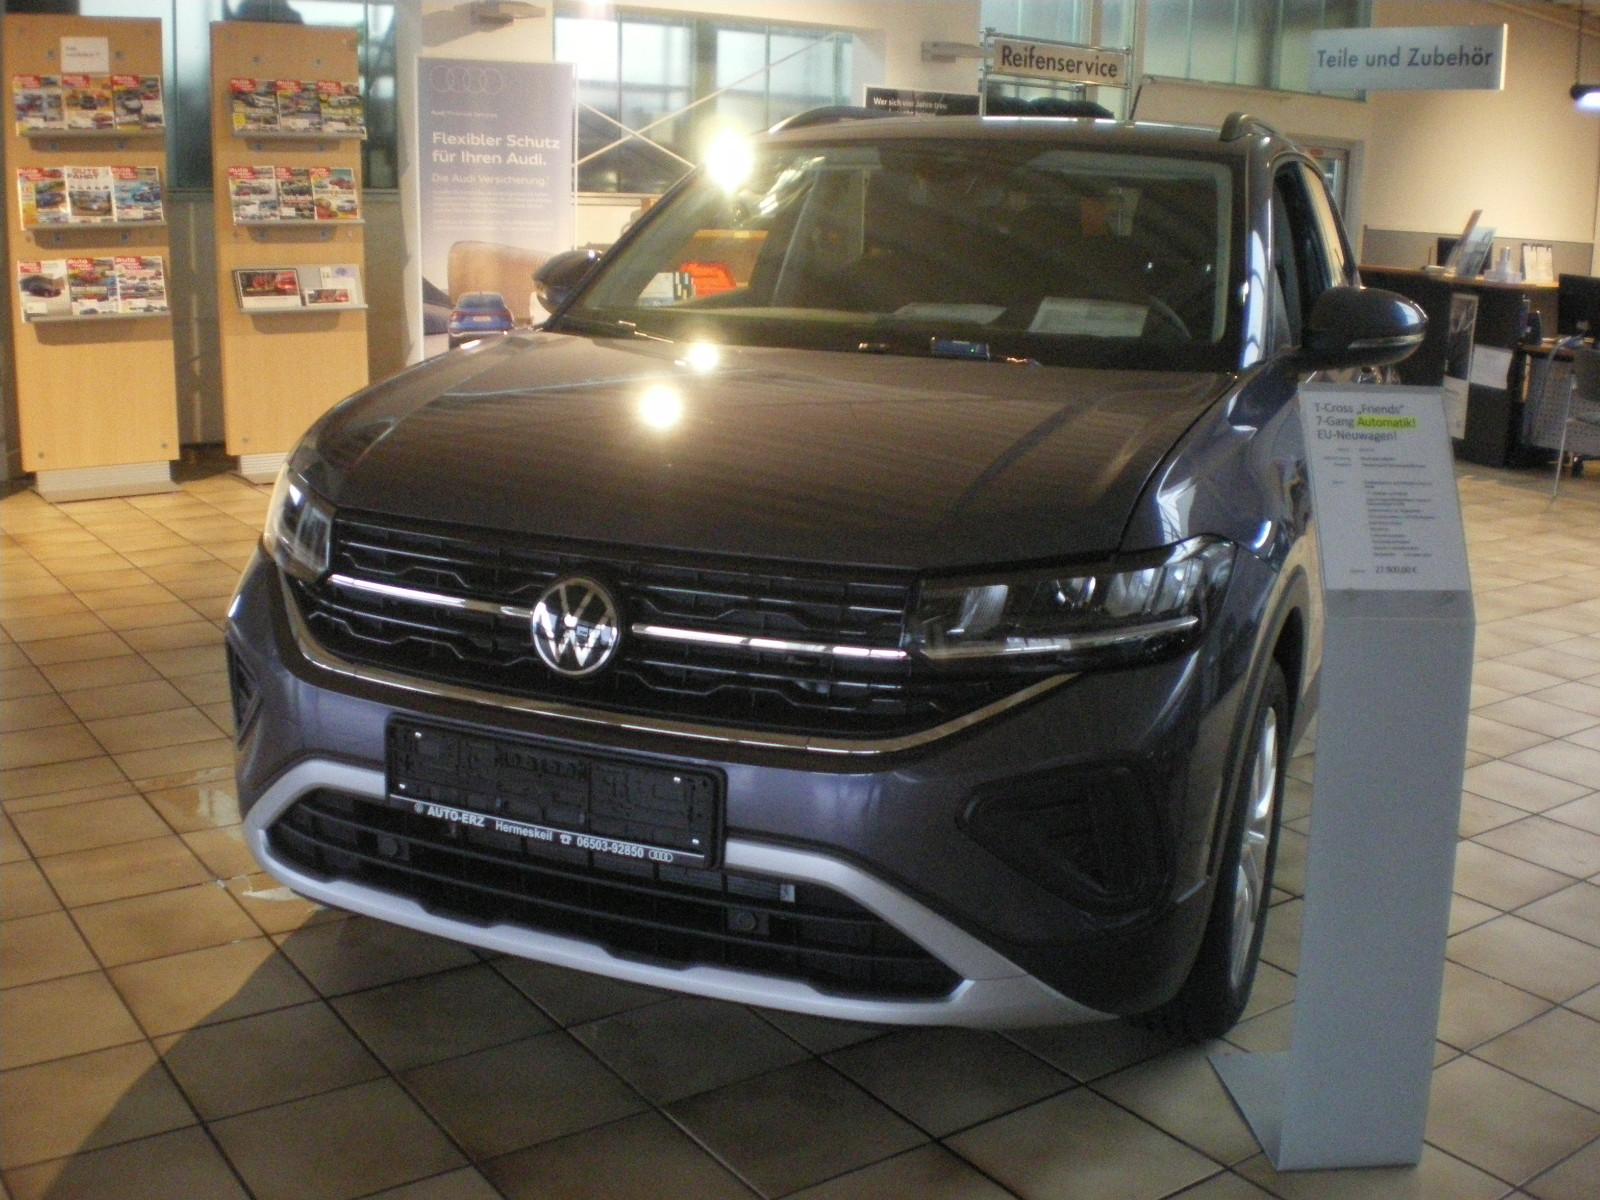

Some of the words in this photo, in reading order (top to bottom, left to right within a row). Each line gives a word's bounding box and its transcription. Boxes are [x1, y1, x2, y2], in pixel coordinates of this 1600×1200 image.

[1001, 44, 1119, 78] Reifenservice
[1317, 48, 1359, 68] Teile
[1365, 46, 1400, 67] und
[1407, 44, 1494, 67] Zubehör
[432, 131, 502, 147] Flexibler
[506, 134, 561, 150] Schutz
[432, 149, 457, 163] für
[461, 151, 502, 164] Ihren
[506, 152, 547, 166] Audi.
[1314, 402, 1354, 414] T-Cross
[1316, 415, 1355, 429] 7-Gang
[1357, 416, 1416, 429] Automatik!
[1317, 429, 1398, 443] EU-Neuwagen!
[427, 805, 485, 828] AUTO-ERZ
[495, 819, 553, 843] Hermeskeil
[576, 834, 645, 860] 06503-92850
